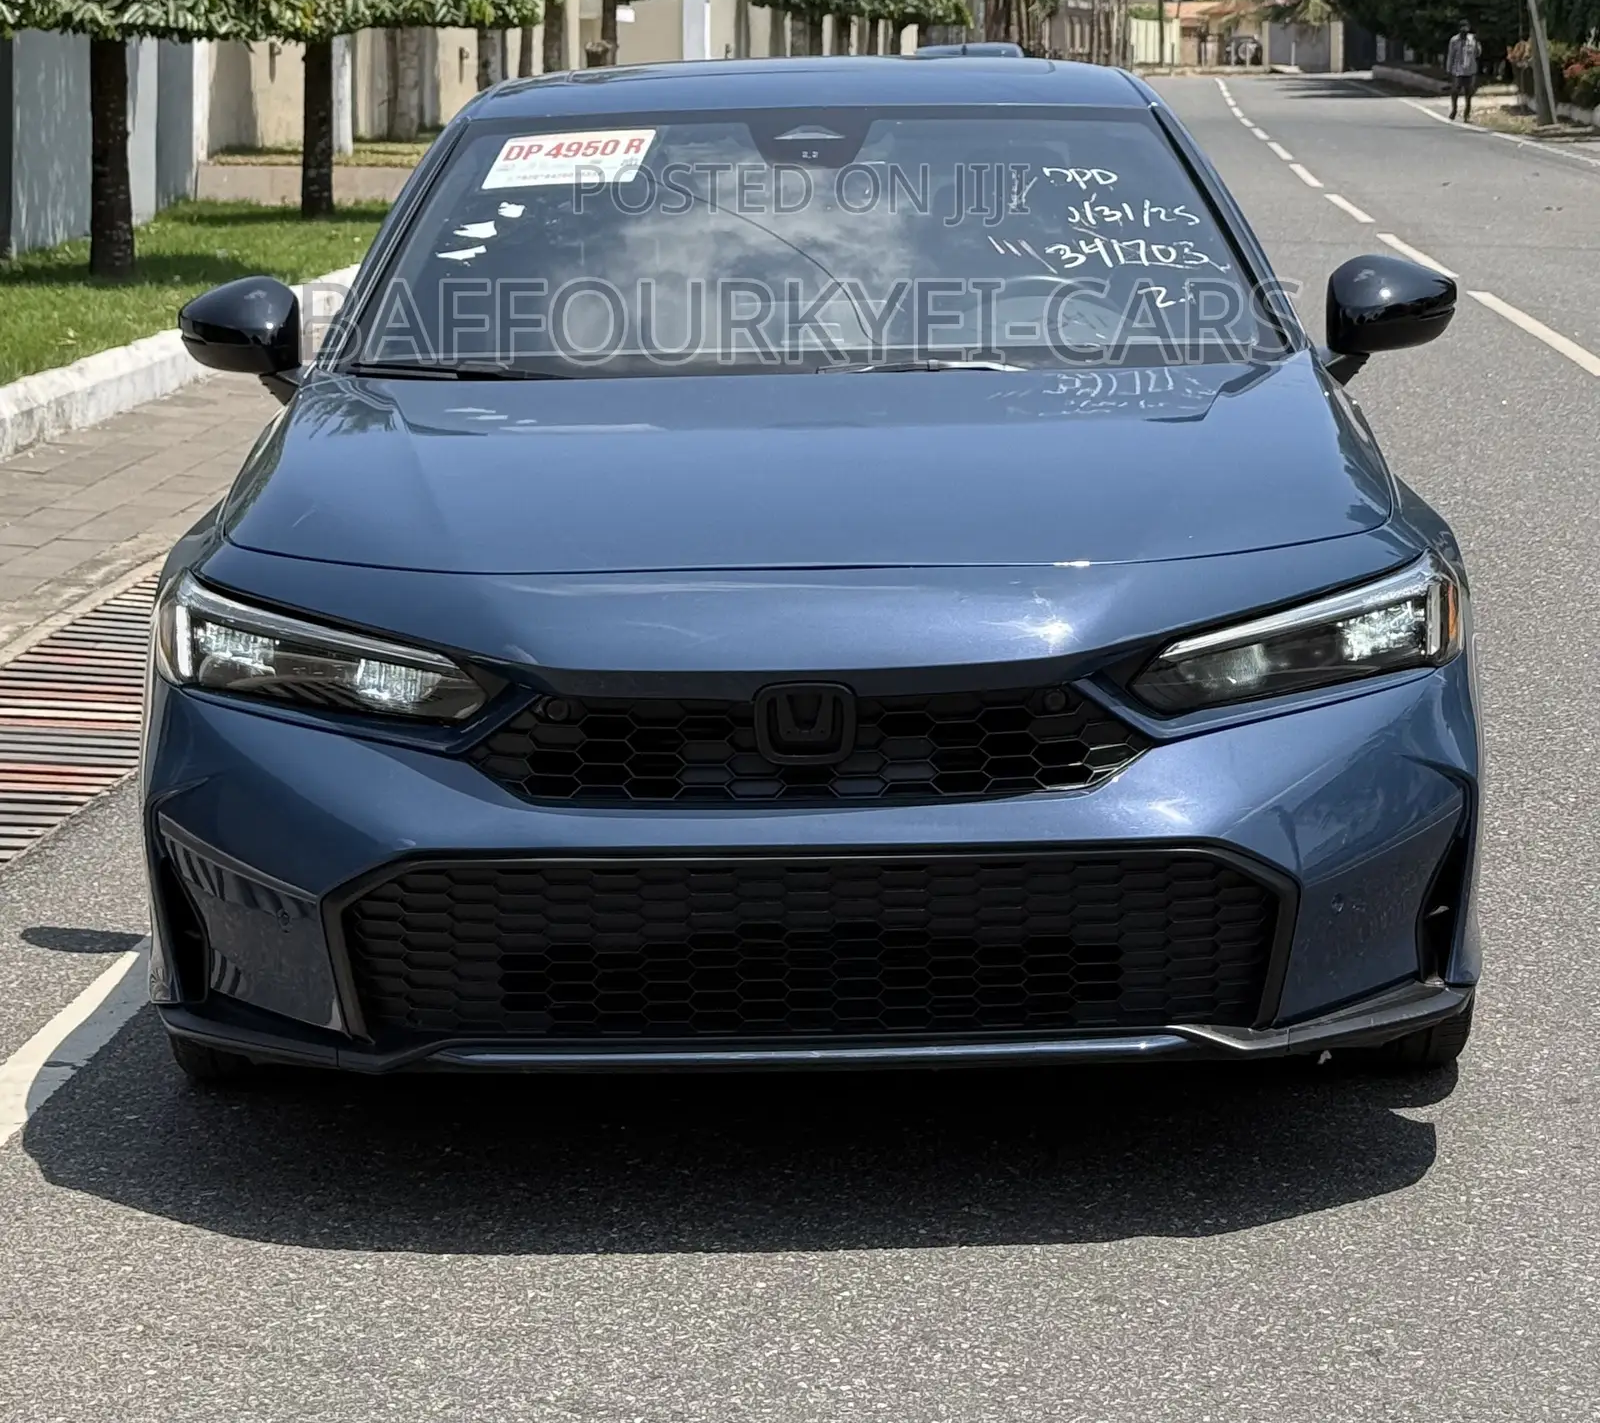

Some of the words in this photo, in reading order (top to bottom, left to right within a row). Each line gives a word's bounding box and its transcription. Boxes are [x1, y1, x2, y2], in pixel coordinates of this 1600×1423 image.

[502, 144, 543, 162] DP
[543, 138, 621, 159] 4950
[623, 137, 646, 155] R
